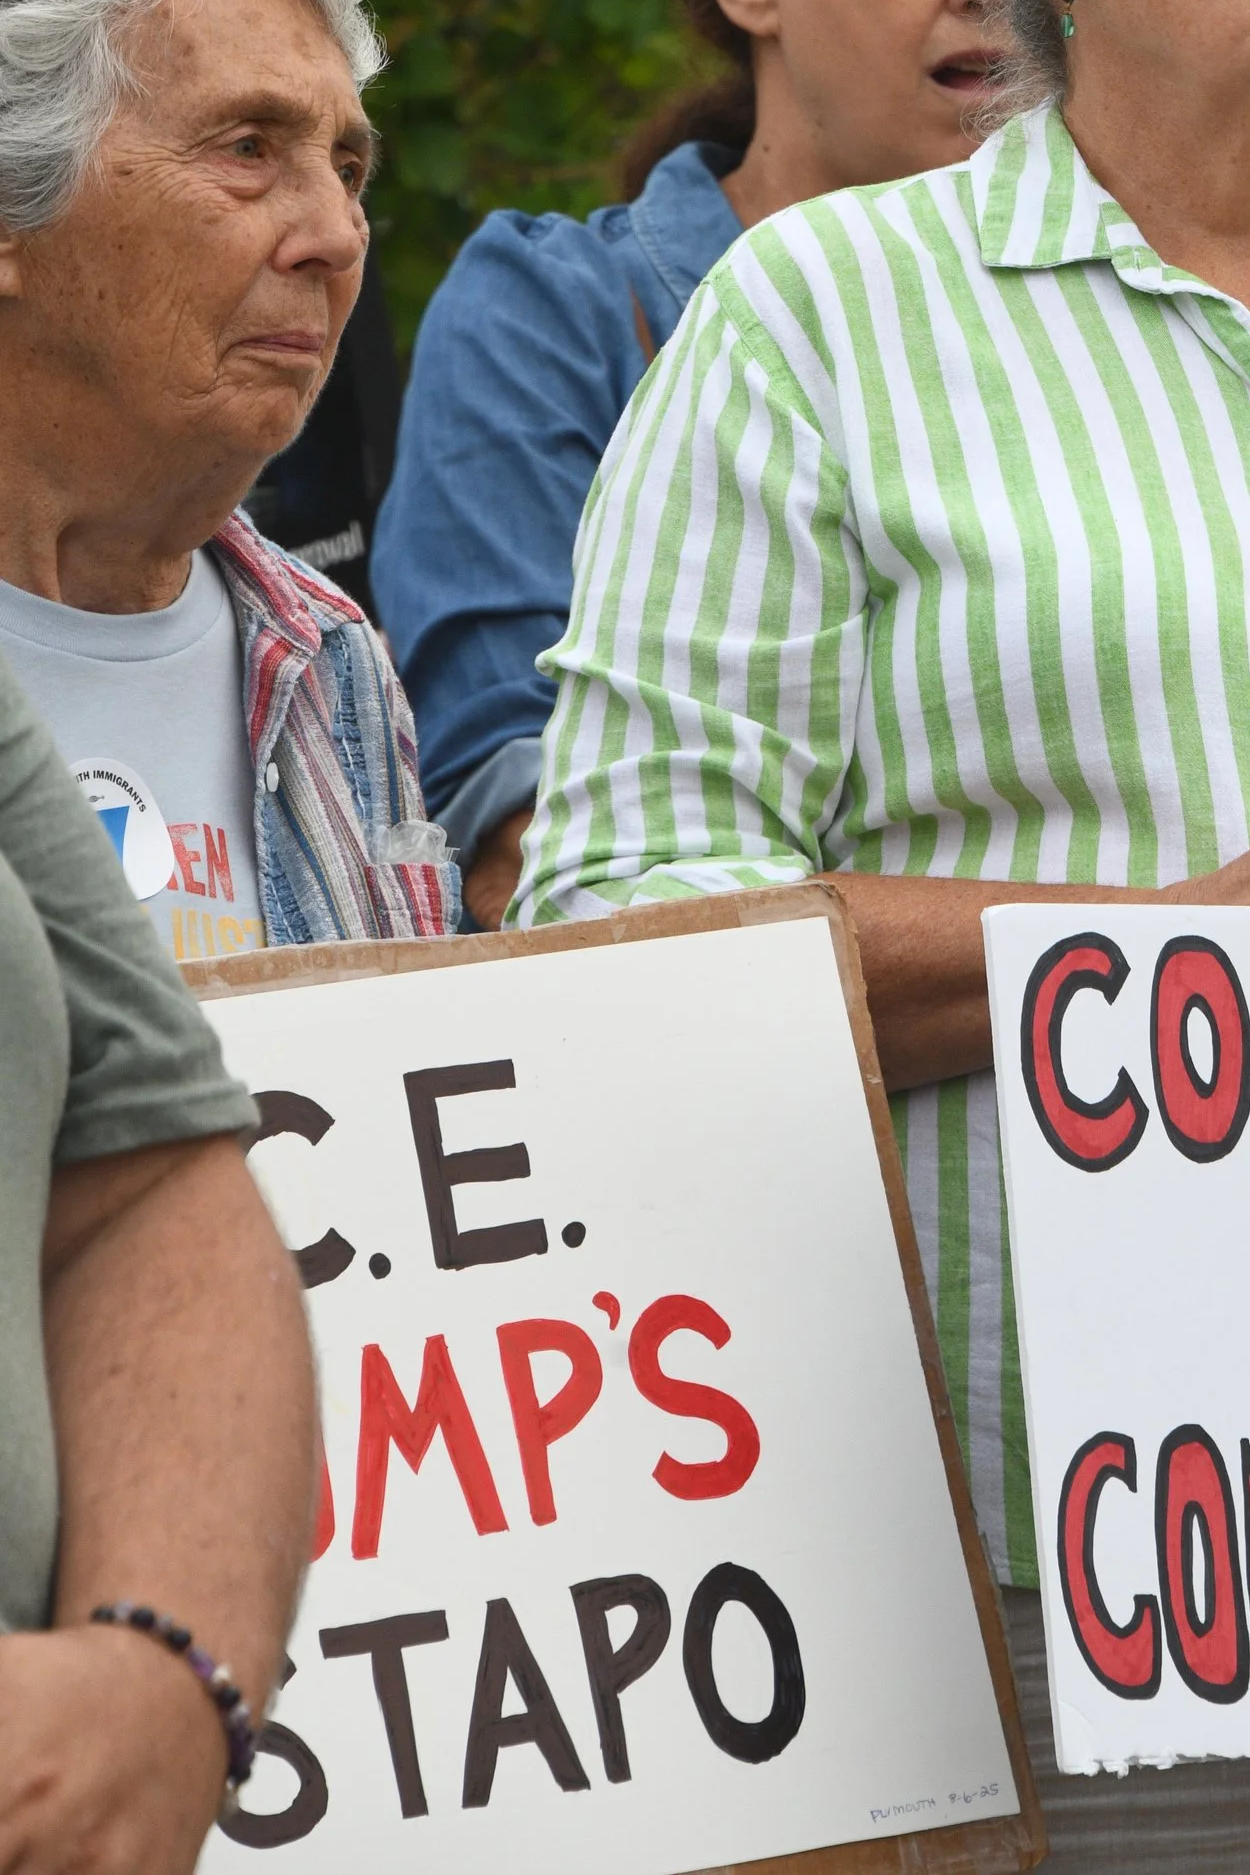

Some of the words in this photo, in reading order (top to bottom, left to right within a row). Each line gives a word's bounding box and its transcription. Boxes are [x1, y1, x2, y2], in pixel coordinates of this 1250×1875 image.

[75, 770, 91, 784] ITH
[93, 769, 147, 813] IMMIGRANTS
[167, 822, 235, 903] EN
[310, 1291, 761, 1563] MP'S
